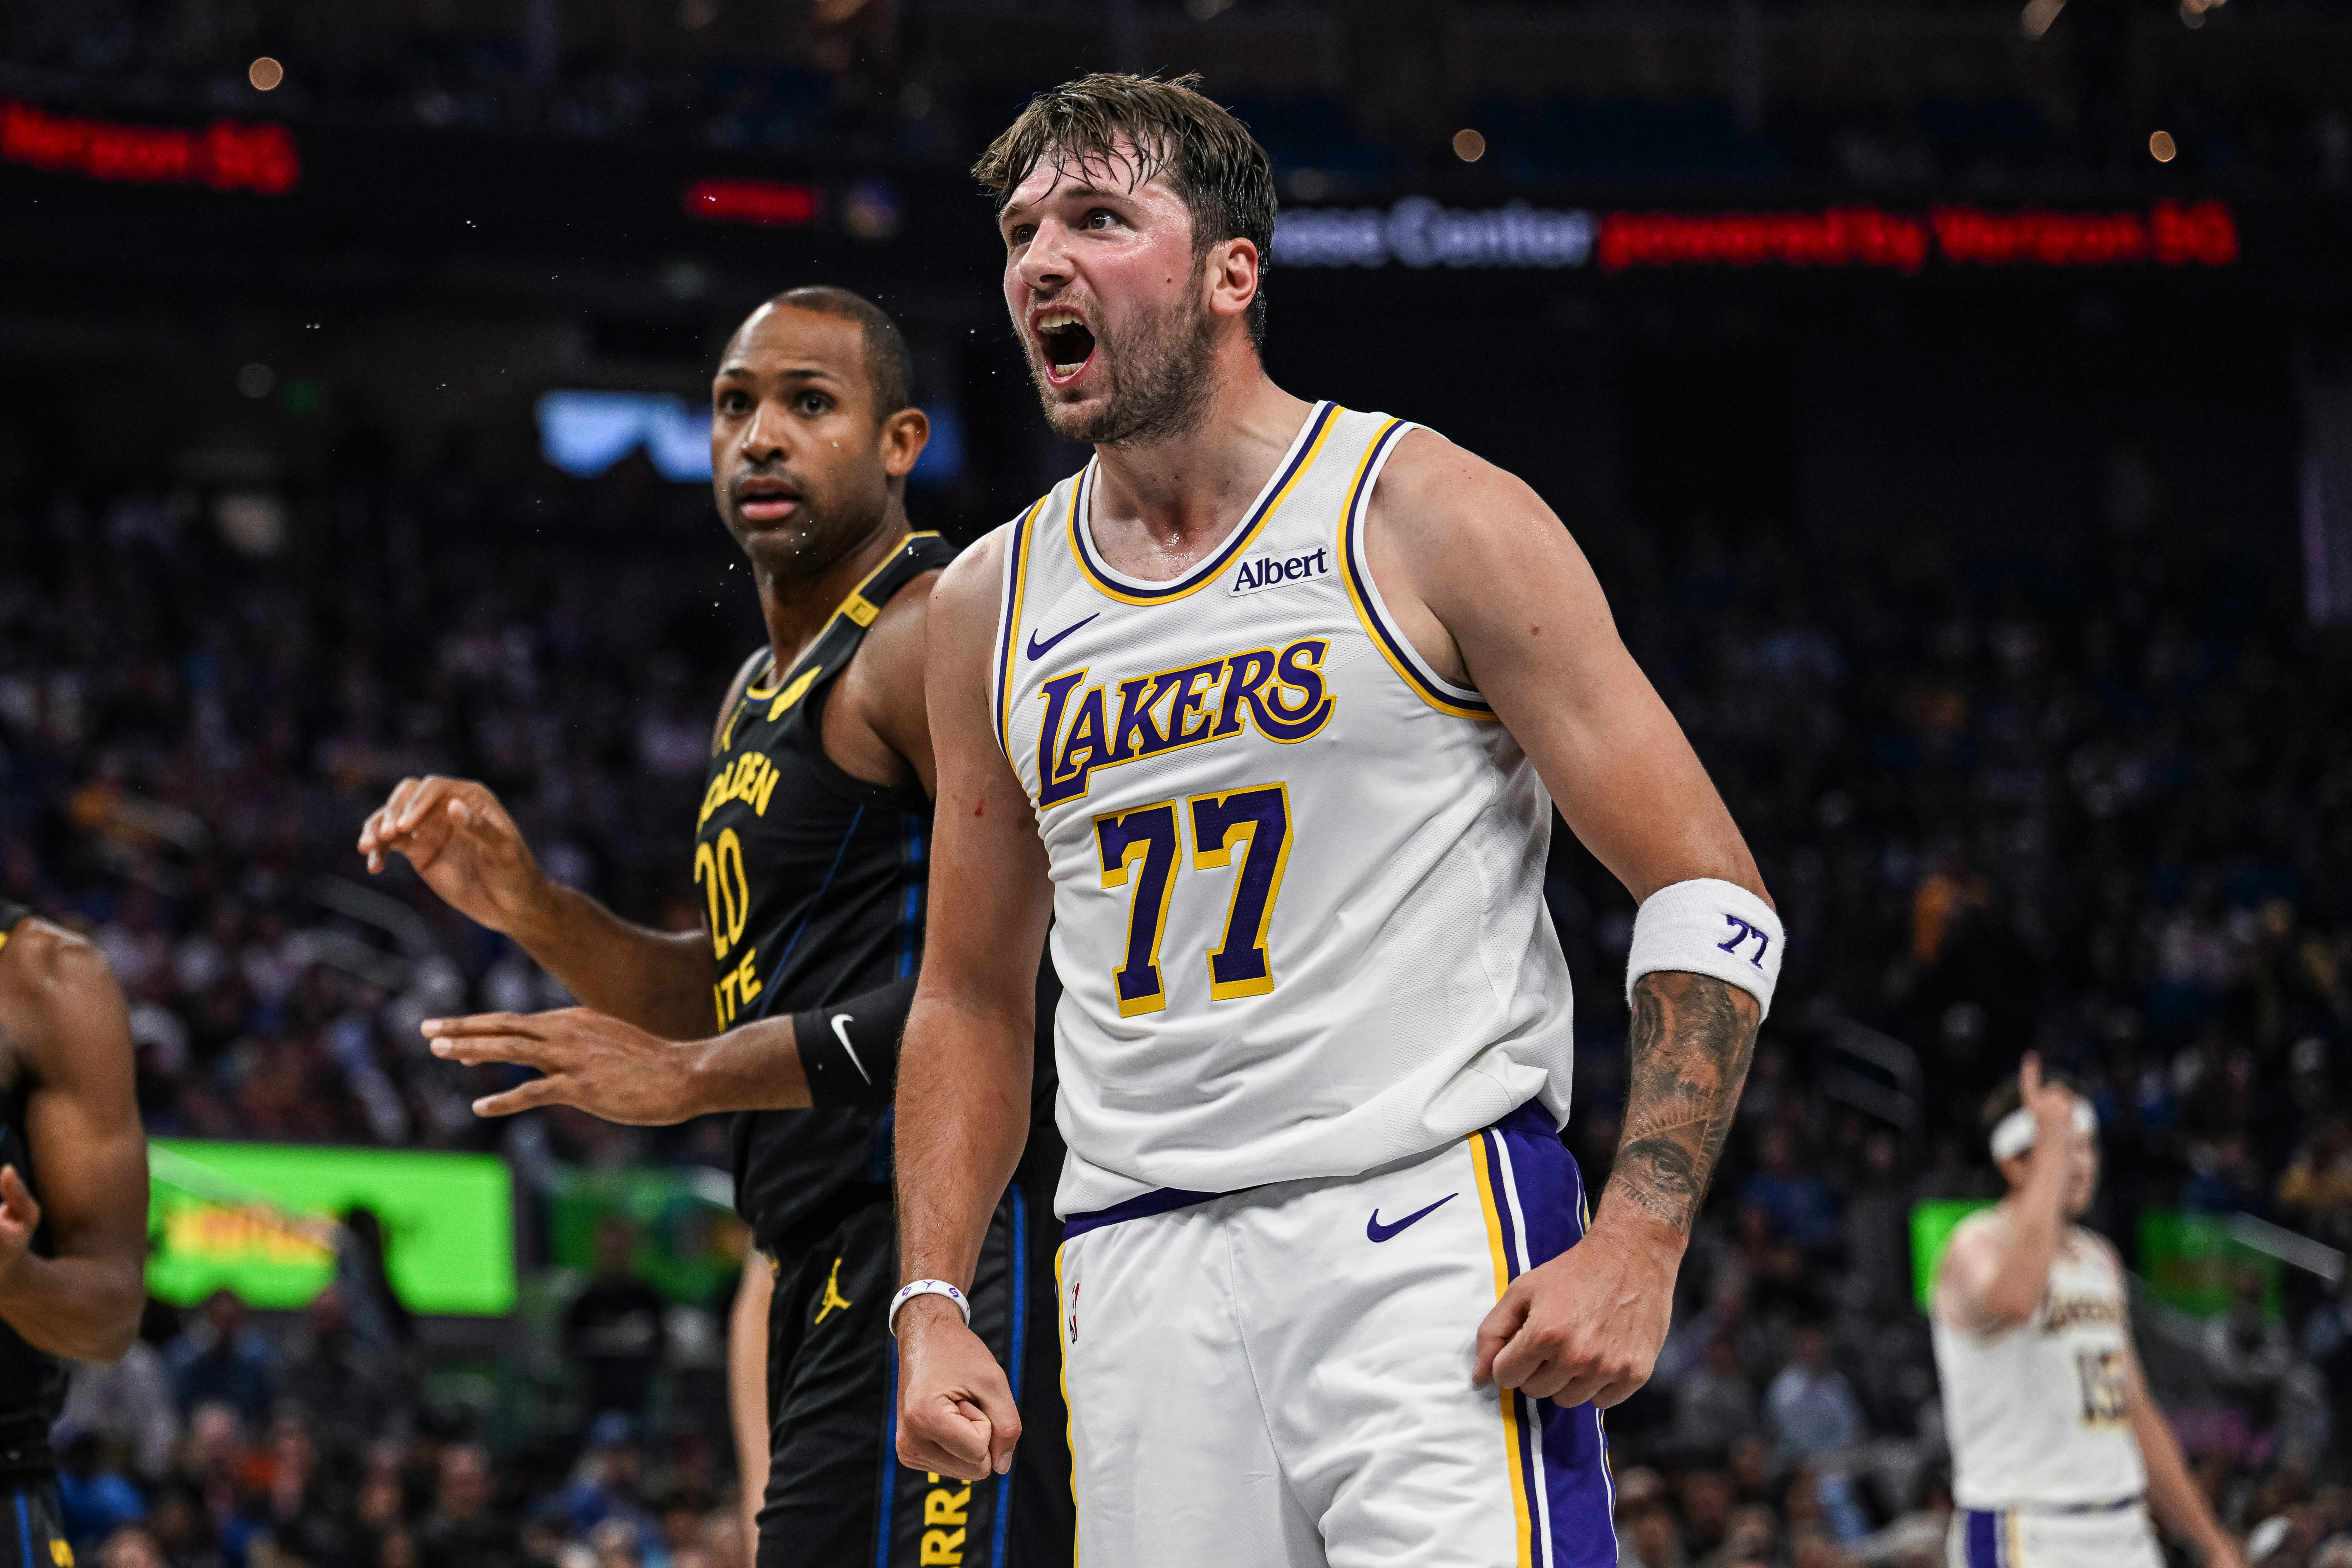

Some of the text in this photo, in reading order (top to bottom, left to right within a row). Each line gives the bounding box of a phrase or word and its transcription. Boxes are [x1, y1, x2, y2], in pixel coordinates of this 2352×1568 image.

[1233, 548, 1329, 592] Albert
[1037, 638, 1337, 811] LAKERS
[694, 827, 750, 961] 20
[1091, 781, 1294, 1019] 77
[1717, 914, 1769, 969] 77
